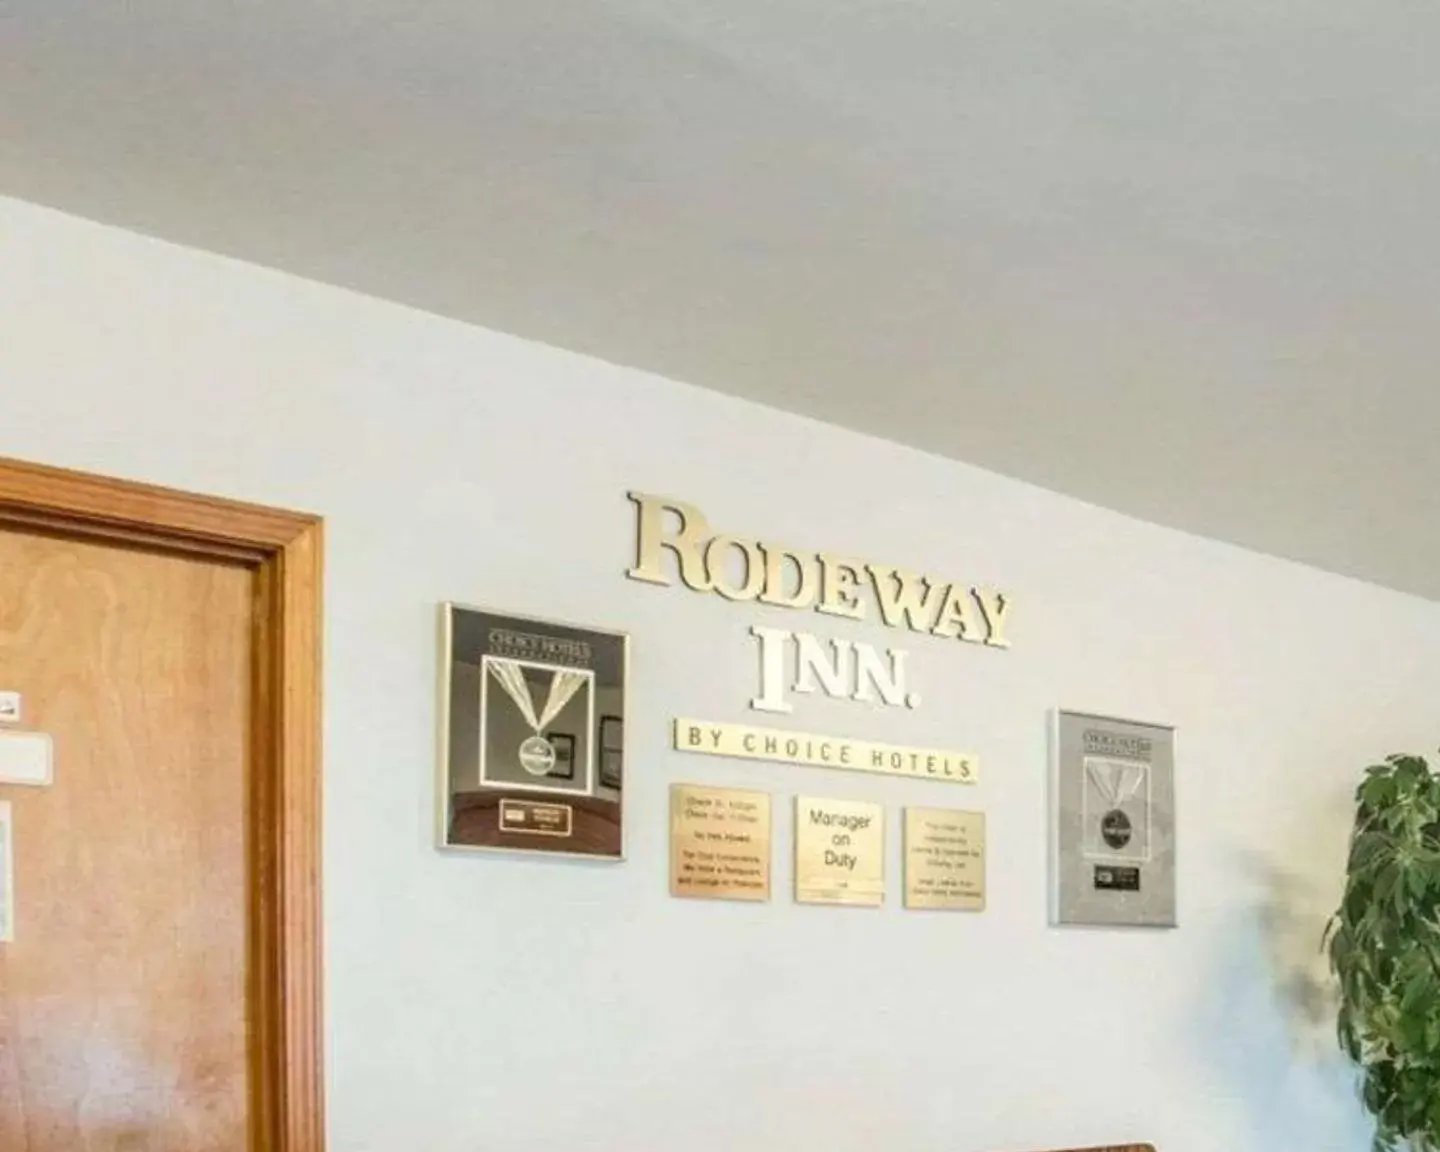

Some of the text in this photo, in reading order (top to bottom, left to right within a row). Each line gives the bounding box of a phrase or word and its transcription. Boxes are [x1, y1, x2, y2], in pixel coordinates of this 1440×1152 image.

[627, 491, 1012, 649] RODEWAY
[688, 727, 973, 778] BY CHOICE HOTELS
[808, 808, 871, 830] Manager
[831, 835, 850, 846] on
[824, 850, 858, 871] Duty
